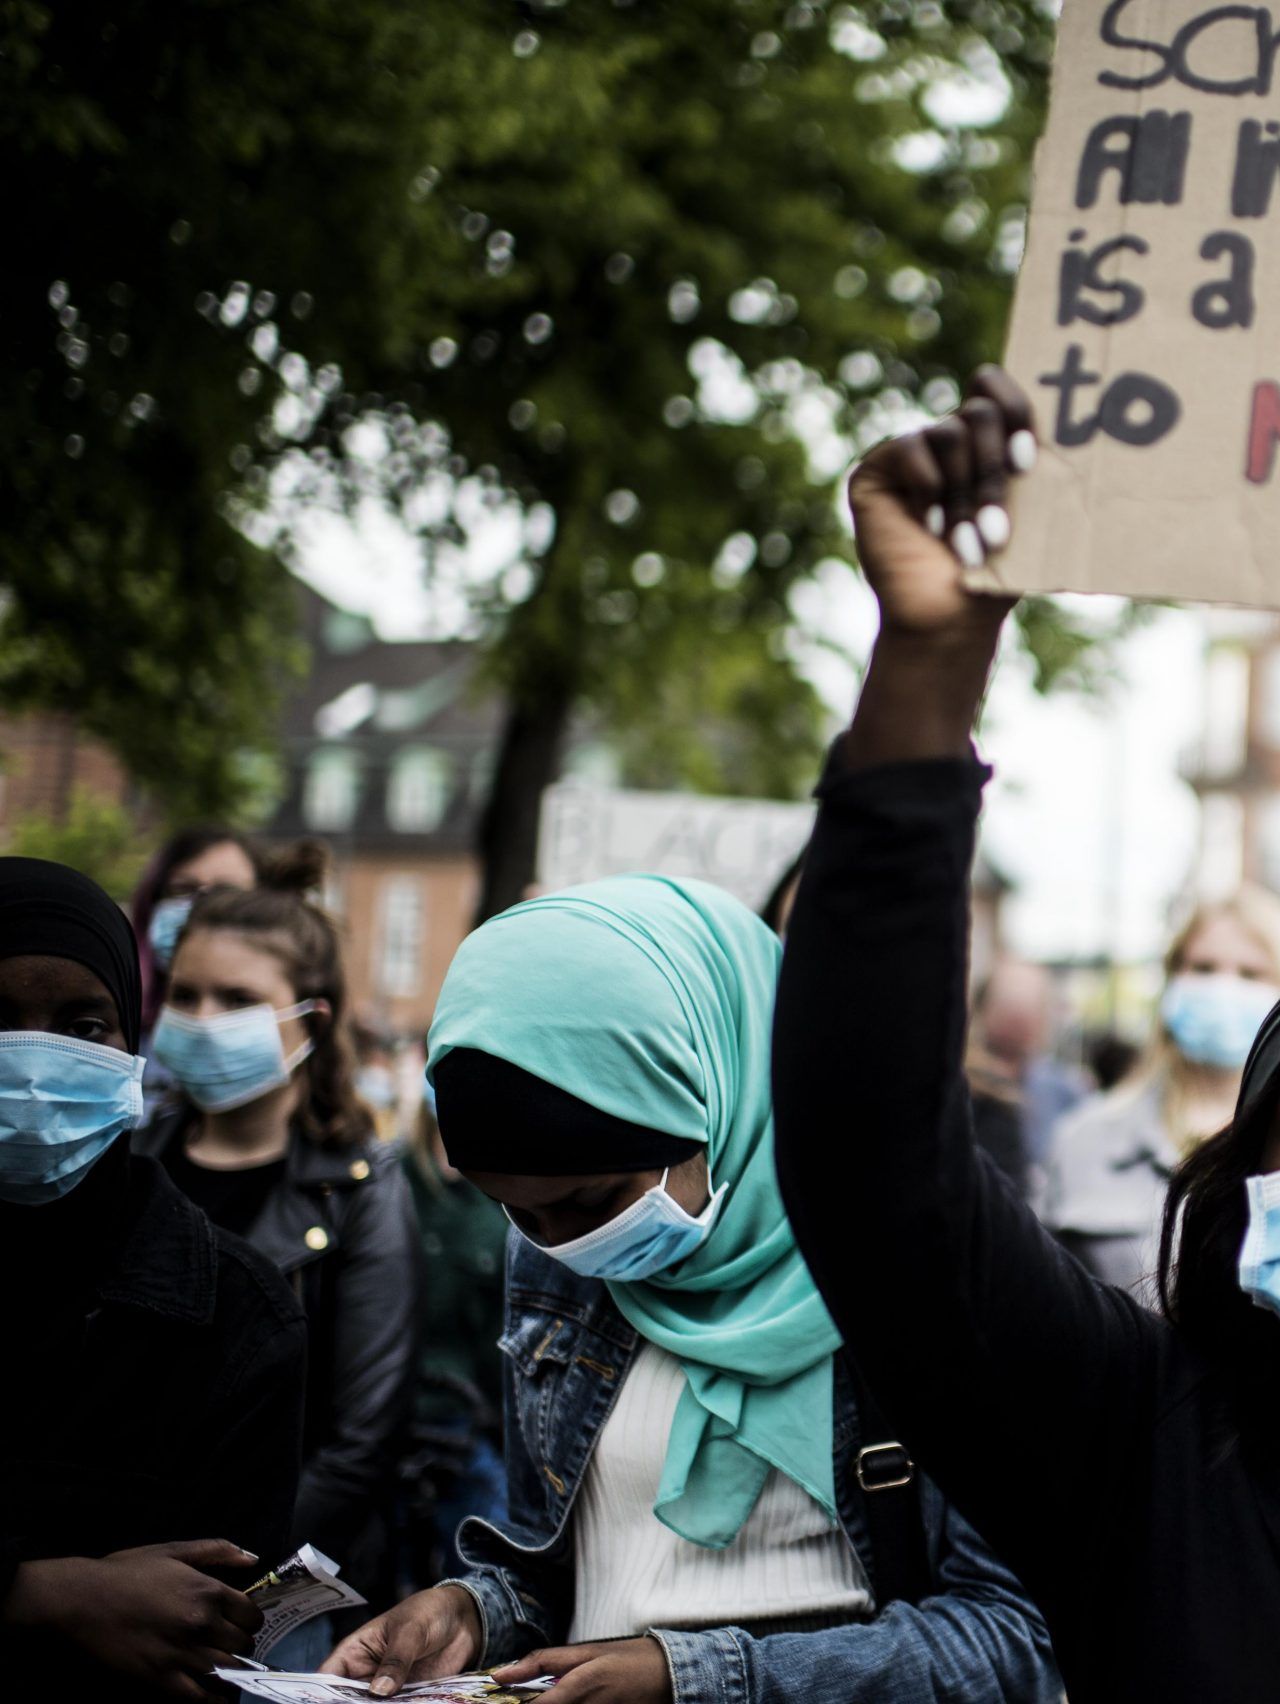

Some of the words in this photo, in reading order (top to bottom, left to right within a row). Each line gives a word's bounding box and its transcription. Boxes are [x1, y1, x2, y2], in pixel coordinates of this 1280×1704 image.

[1074, 109, 1193, 211] All
[1055, 228, 1151, 330] is
[1190, 230, 1256, 331] a
[1037, 344, 1182, 449] to
